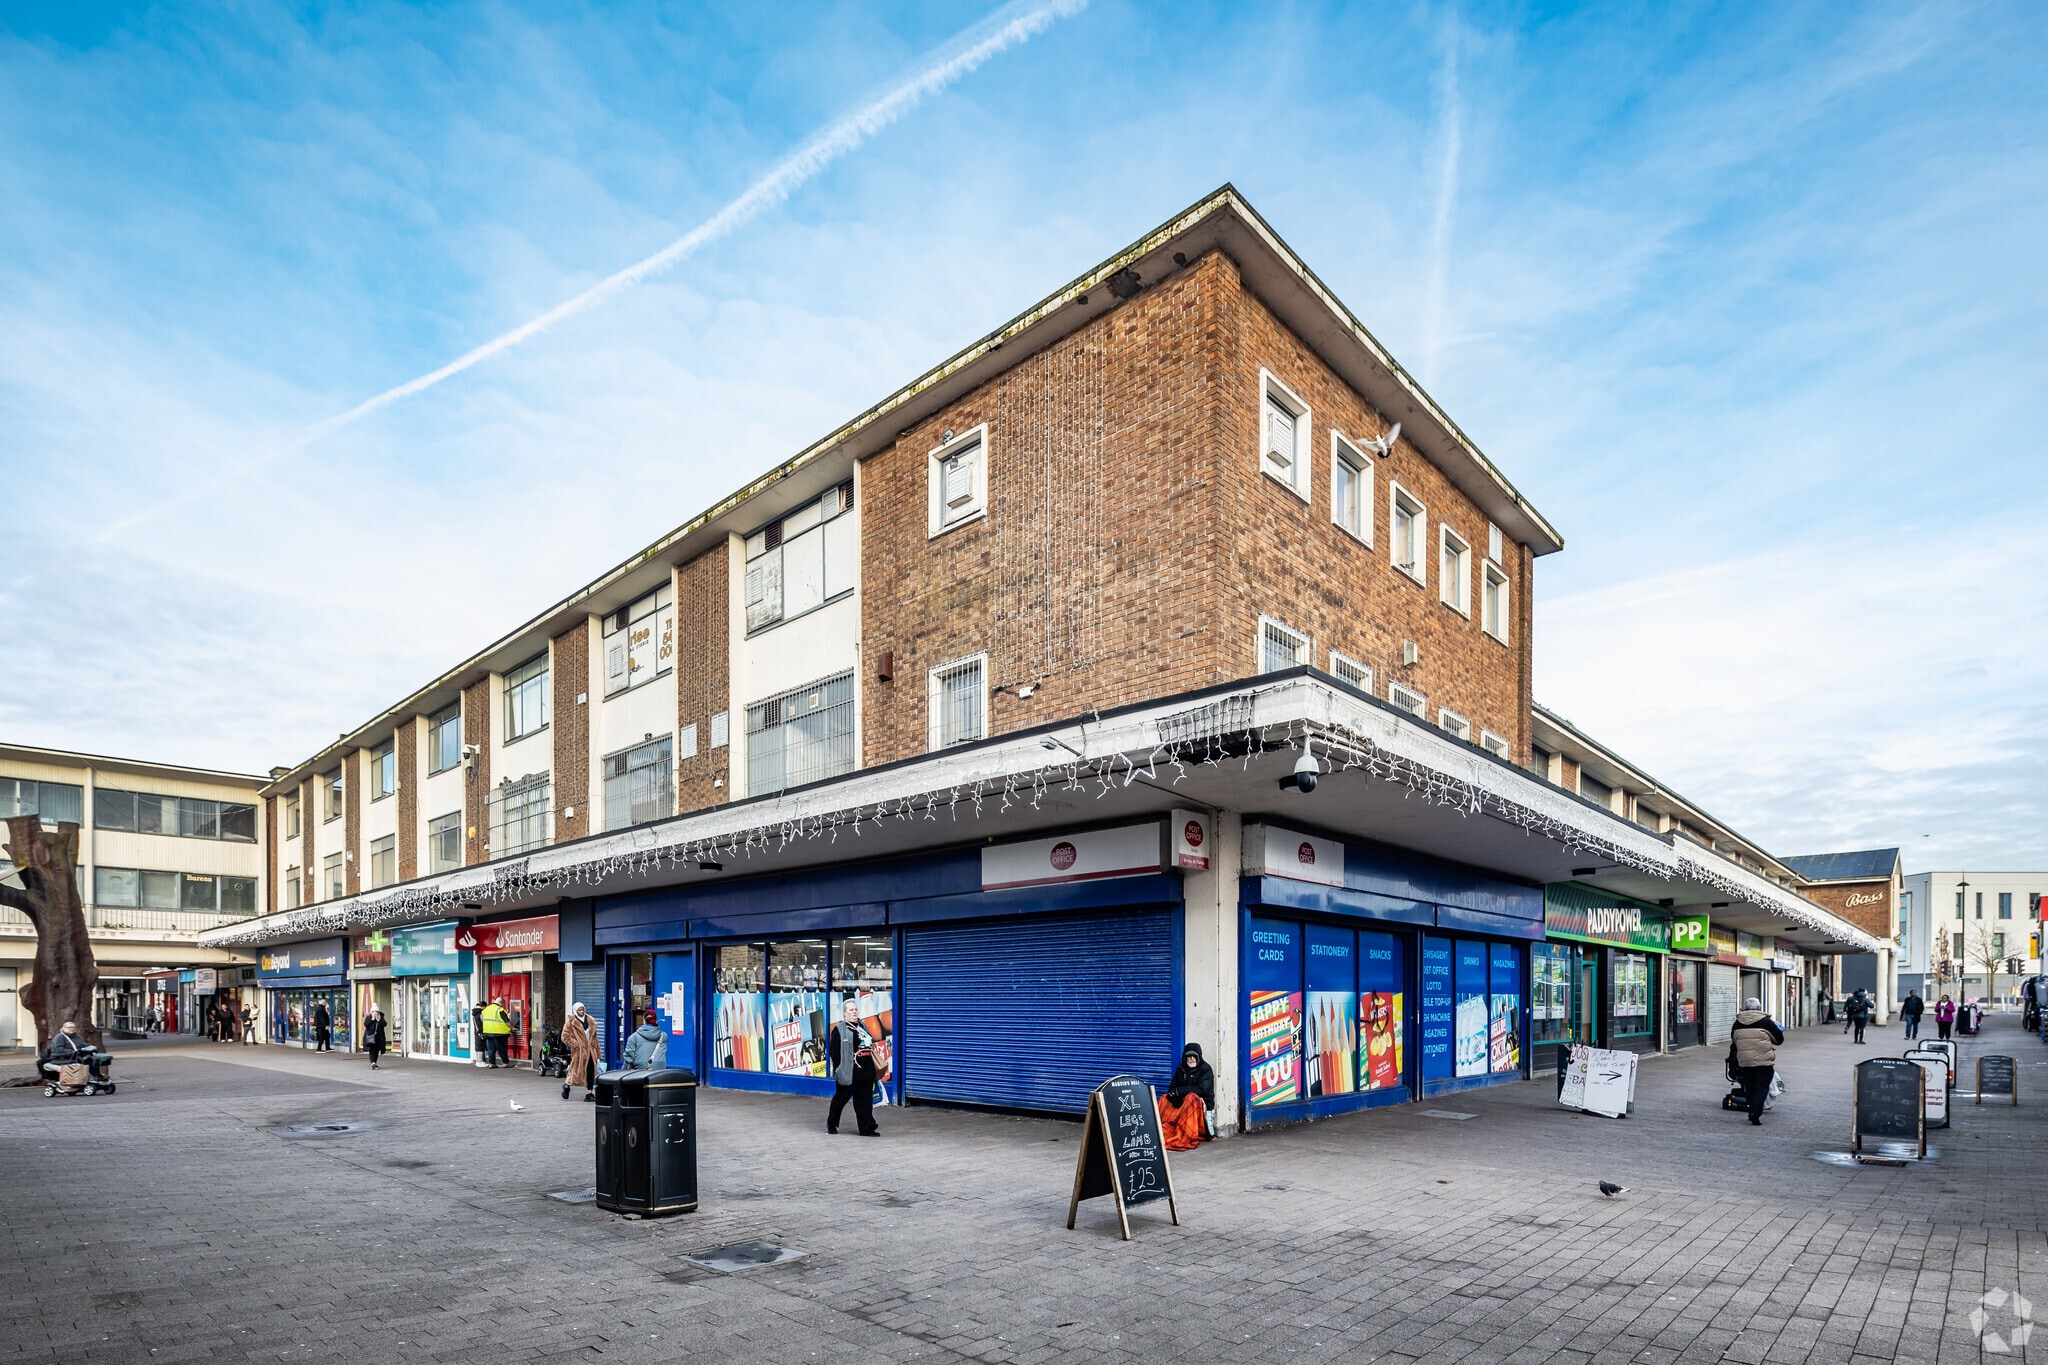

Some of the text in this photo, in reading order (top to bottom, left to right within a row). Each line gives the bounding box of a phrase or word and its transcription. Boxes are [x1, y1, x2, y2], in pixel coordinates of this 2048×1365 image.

[1188, 825, 1200, 834] POST
[1186, 831, 1202, 842] OFFICE
[1055, 847, 1072, 856] POST
[1301, 847, 1313, 856] POST
[1052, 855, 1074, 864] OFFICE
[1300, 855, 1314, 864] OFFICE
[186, 874, 213, 883] Bureau
[1845, 891, 1884, 908] Bass
[1587, 908, 1642, 934] PADDYPOWER
[505, 931, 544, 948] Santander
[1252, 931, 1290, 945] GREETING
[1258, 949, 1285, 961] CARDS
[1311, 944, 1349, 957] STATIONERY
[1369, 949, 1392, 960] SNACKS
[1464, 957, 1479, 966] DRINKS
[1493, 959, 1515, 969] MAGAZINES
[1432, 966, 1449, 976] OFFICE
[1426, 981, 1442, 991] LOTTO
[1430, 1012, 1451, 1022] MACHINE
[774, 1021, 801, 1043] HELLO!
[1262, 1037, 1279, 1059] TO
[777, 1050, 798, 1069] OK!
[1252, 1054, 1292, 1093] YOU
[1118, 1095, 1141, 1112] XL
[1120, 1114, 1145, 1128] LEGS
[1123, 1133, 1151, 1148] LAMB
[1129, 1166, 1156, 1195] £25
